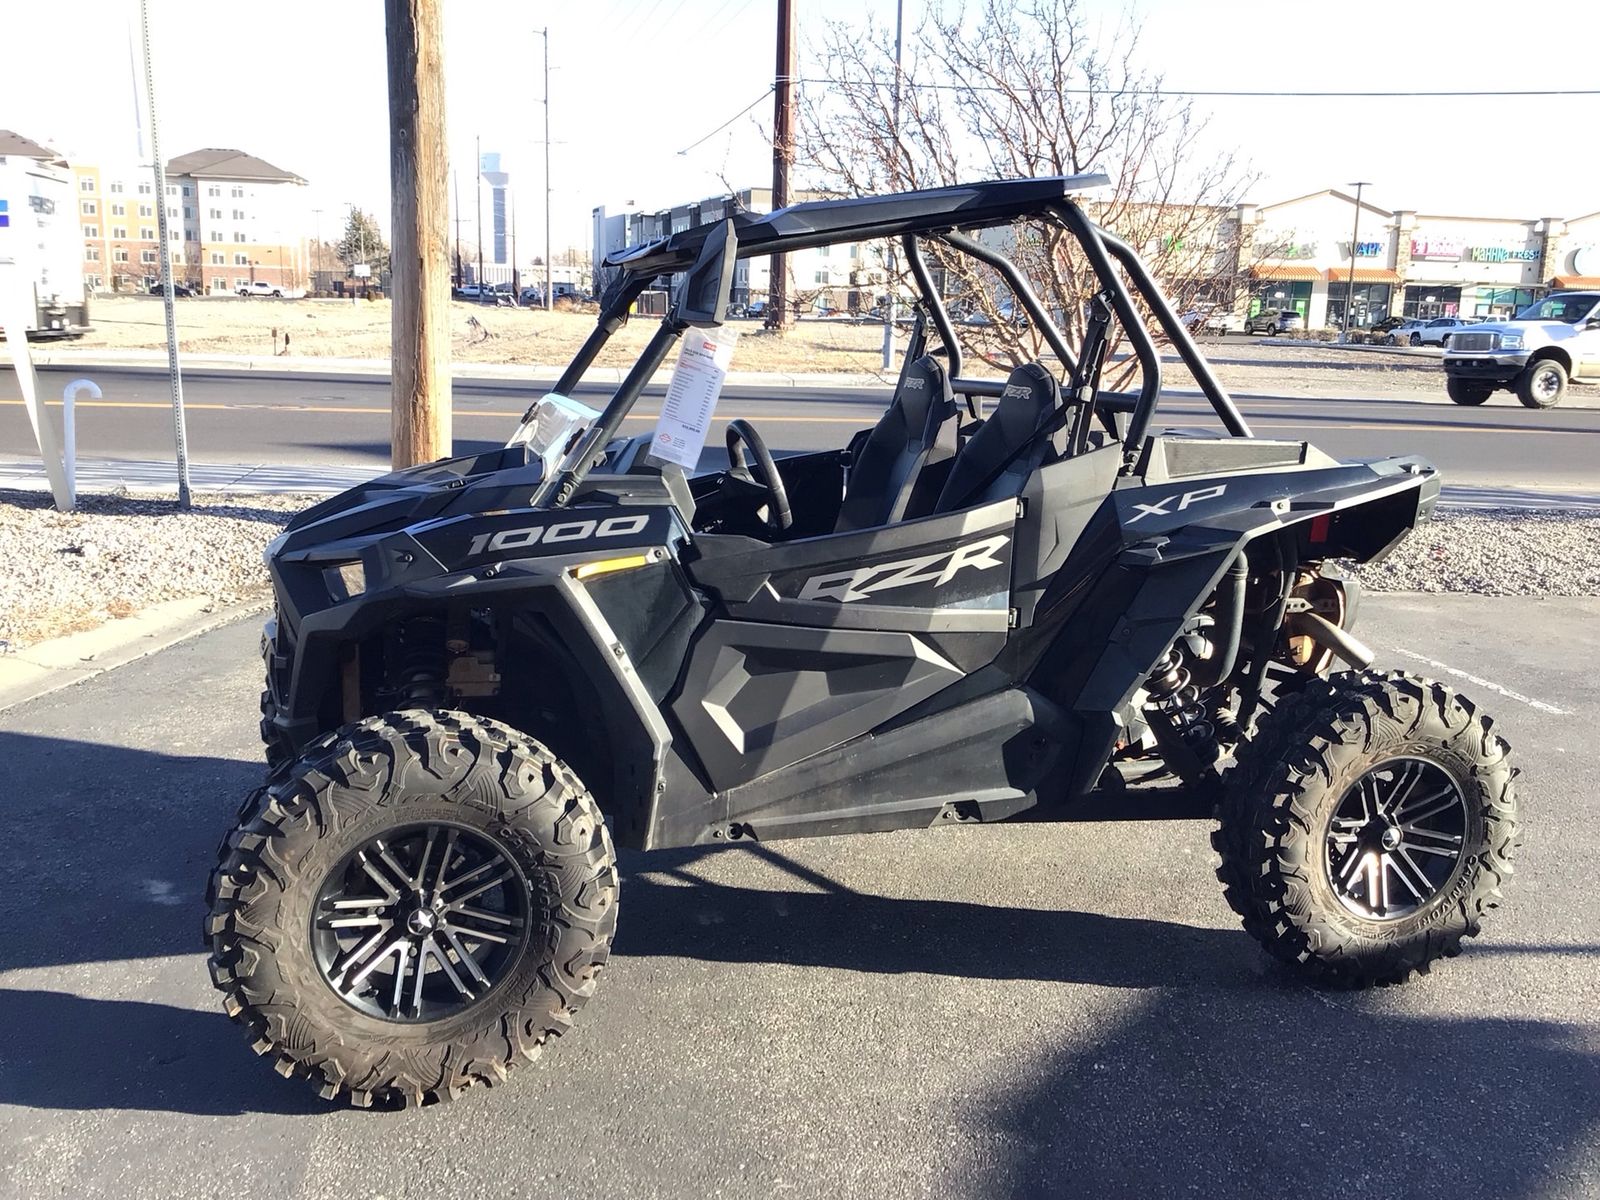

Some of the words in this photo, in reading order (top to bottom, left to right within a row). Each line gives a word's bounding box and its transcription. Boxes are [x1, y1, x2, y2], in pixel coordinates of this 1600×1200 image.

[904, 377, 925, 390] RZR
[1003, 384, 1032, 400] RZR
[1124, 484, 1227, 525] XP
[467, 514, 650, 556] 1000
[797, 534, 1011, 603] RZR
